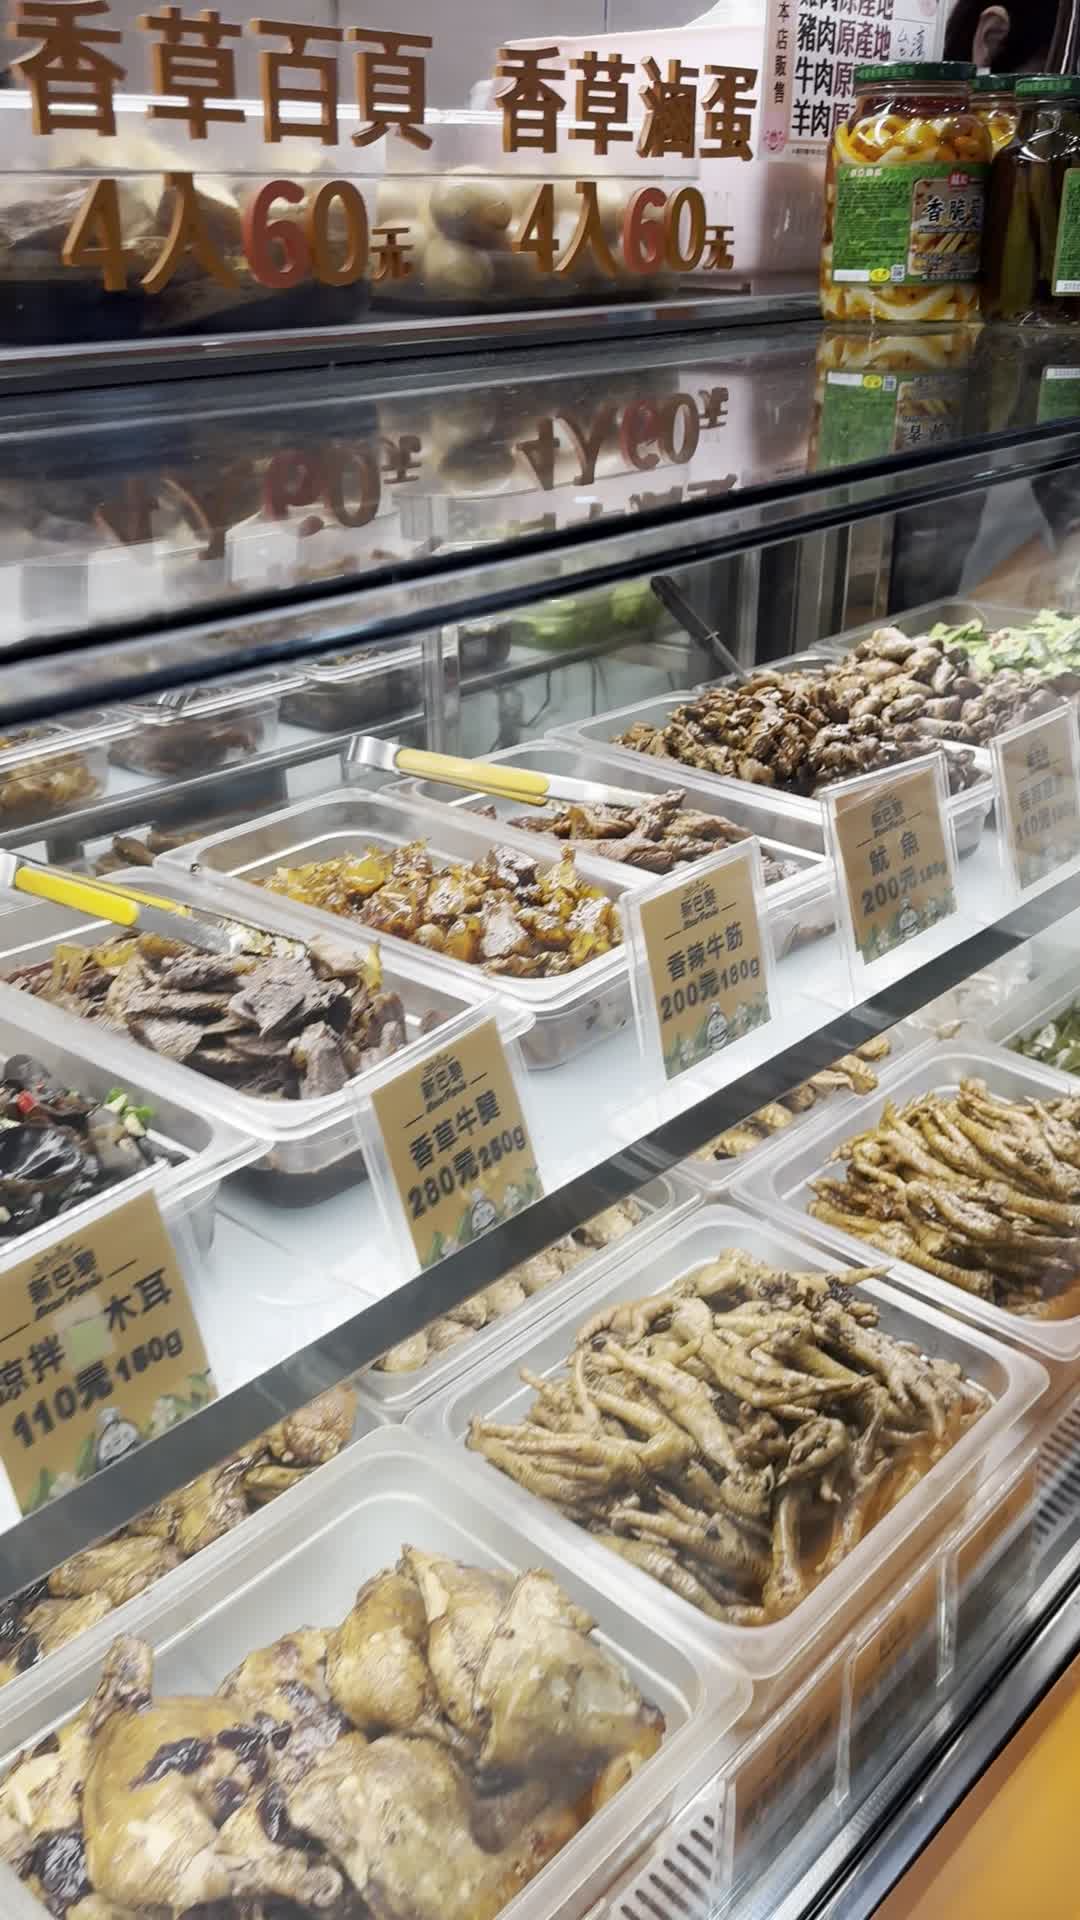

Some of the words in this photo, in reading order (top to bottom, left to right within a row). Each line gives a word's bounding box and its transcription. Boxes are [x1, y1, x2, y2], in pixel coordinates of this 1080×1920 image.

[797, 13, 891, 61] 豬肉原產地
[9, 0, 433, 150] 香草百頁
[495, 46, 759, 161] 香草滷蛋
[795, 56, 855, 98] 牛肉原
[792, 99, 855, 137] 羊肉原
[667, 920, 744, 982] 香辣牛筋
[103, 1266, 173, 1333] 木耳
